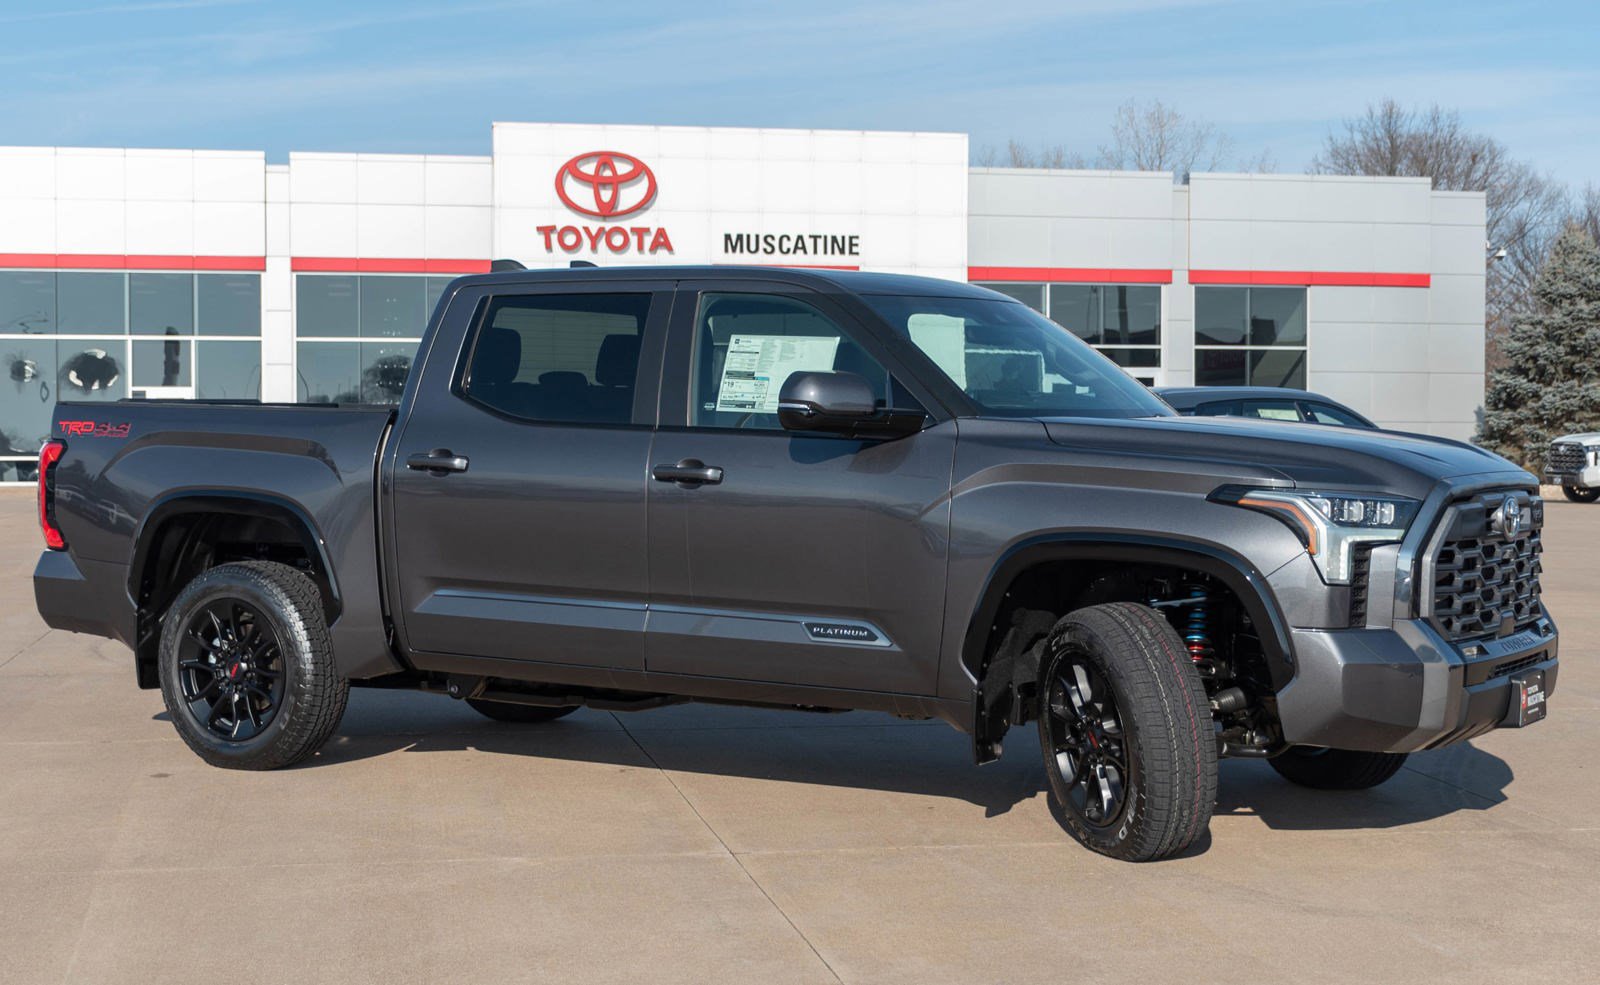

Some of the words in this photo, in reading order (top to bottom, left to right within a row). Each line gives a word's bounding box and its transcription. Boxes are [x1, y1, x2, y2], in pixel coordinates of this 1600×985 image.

[536, 225, 674, 253] TOYOTA
[724, 233, 860, 256] MUSCATINE
[58, 421, 95, 436] TRD
[813, 627, 868, 636] PLATINUM
